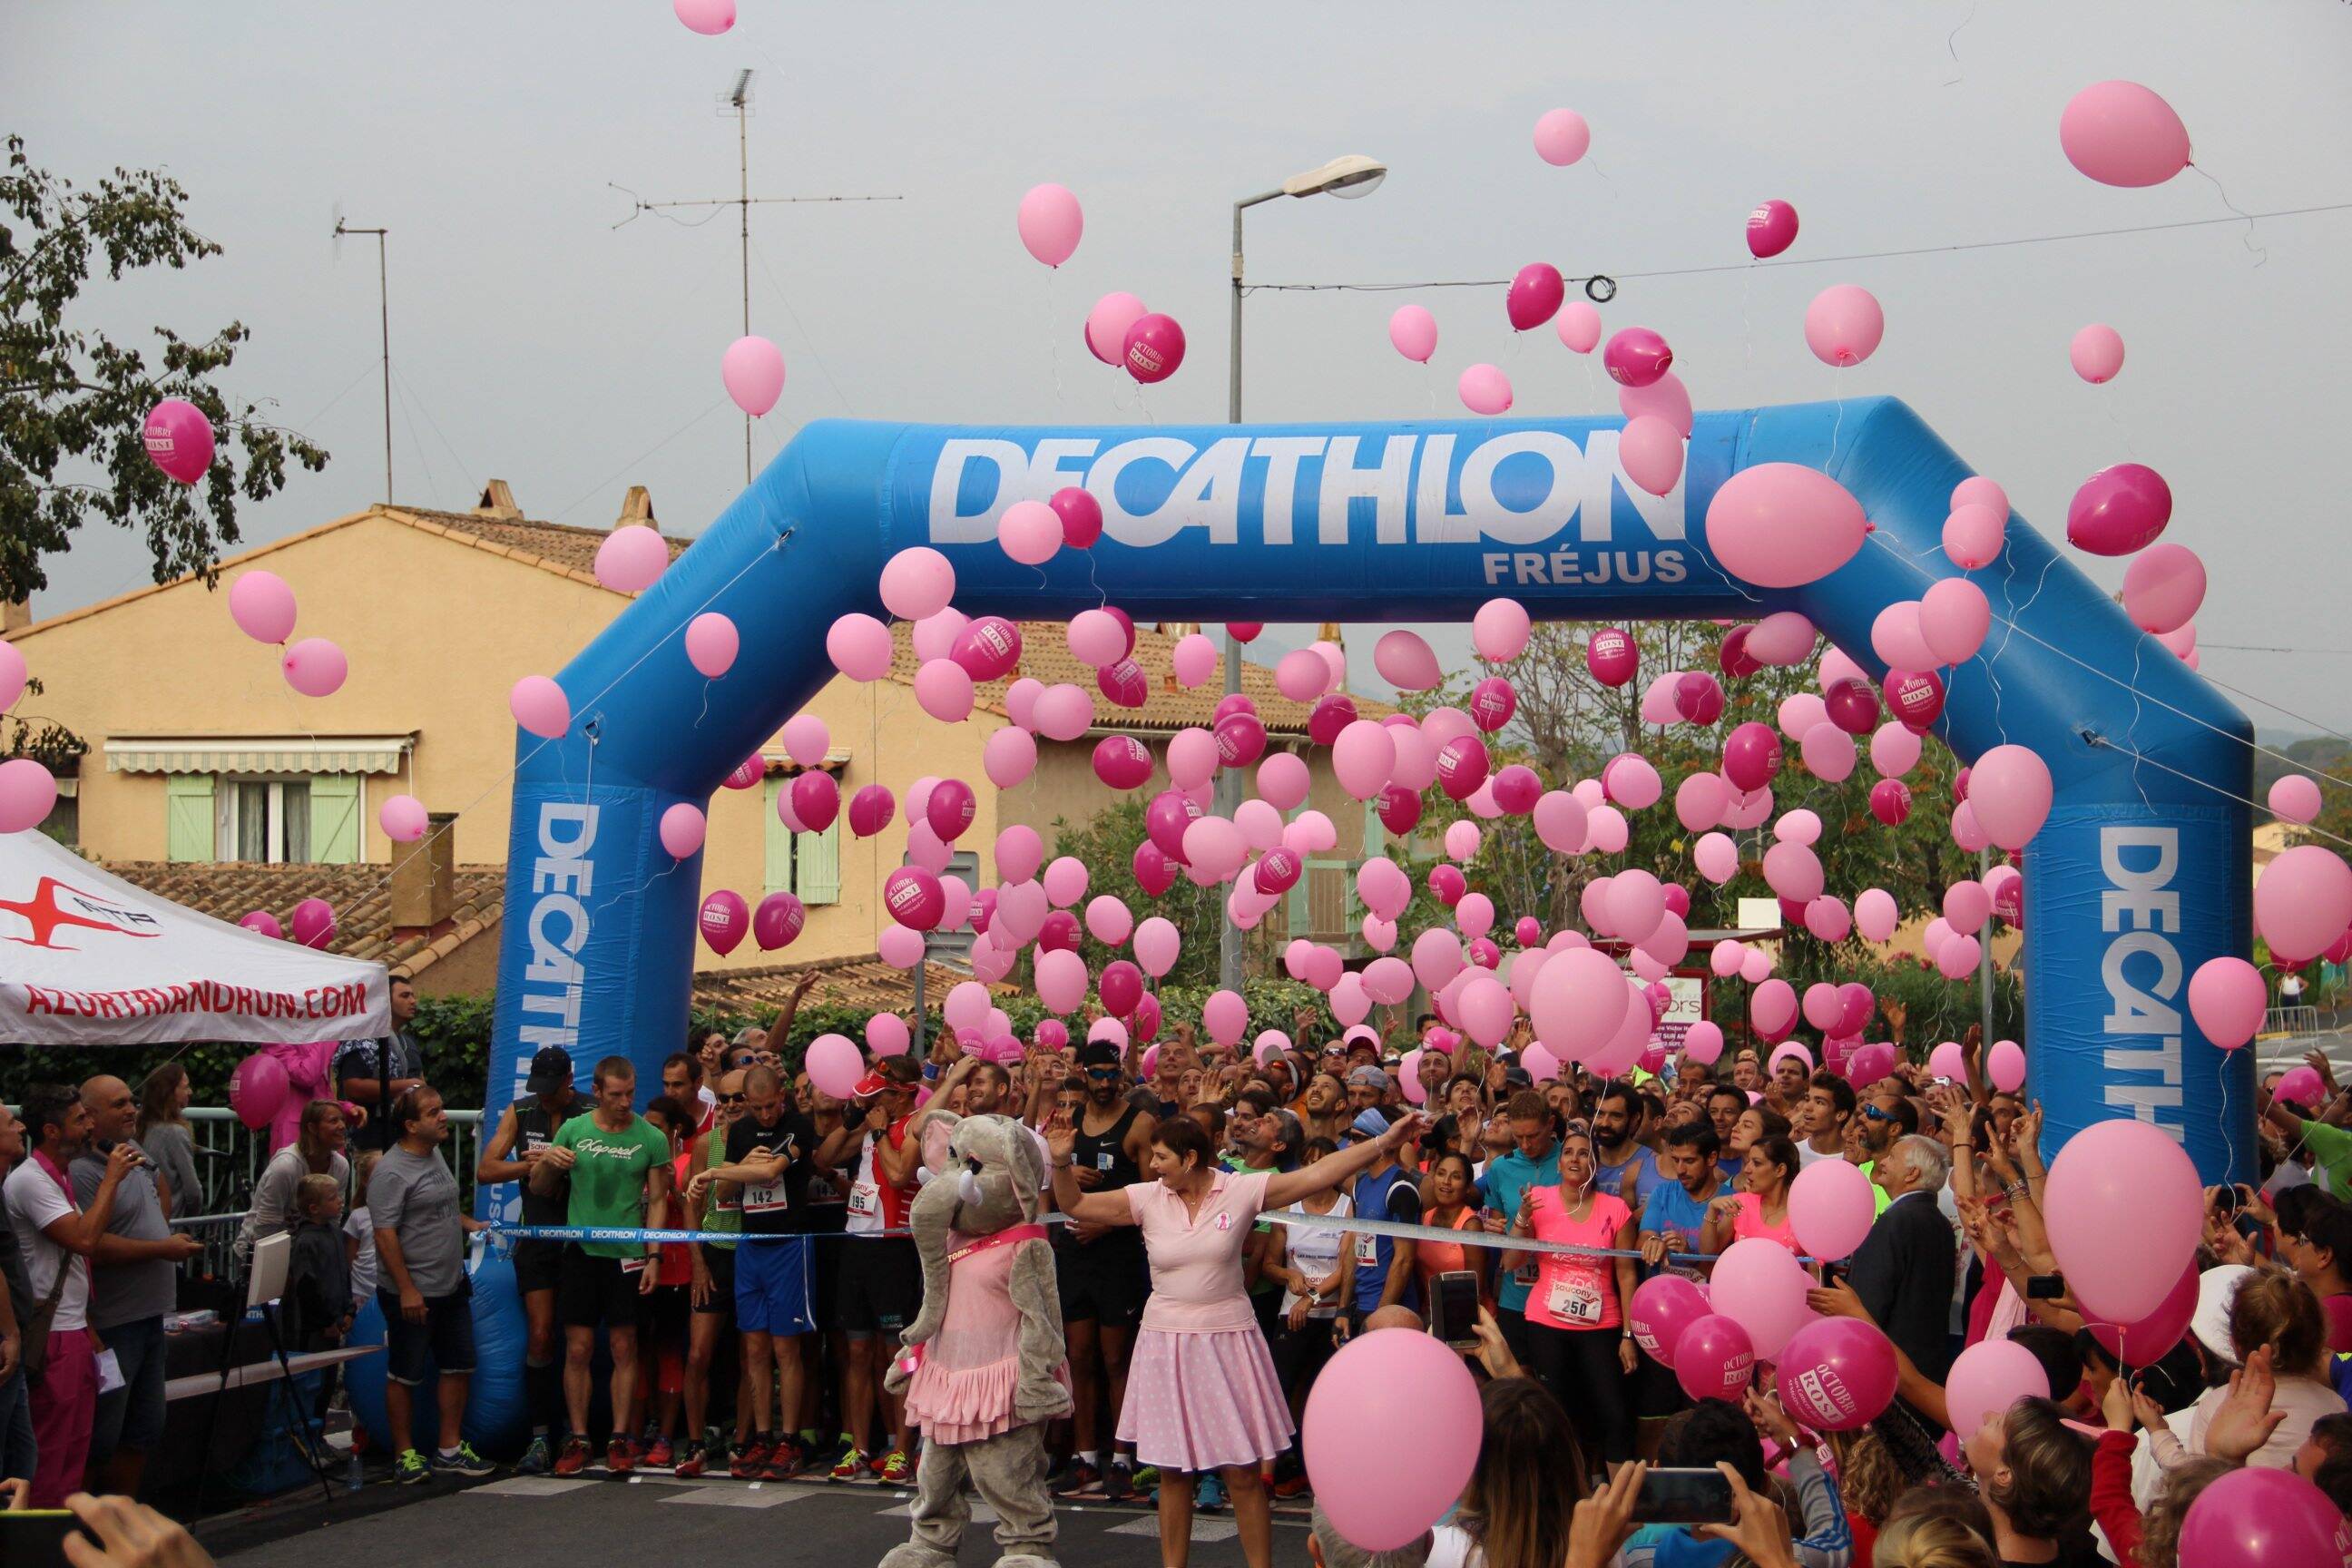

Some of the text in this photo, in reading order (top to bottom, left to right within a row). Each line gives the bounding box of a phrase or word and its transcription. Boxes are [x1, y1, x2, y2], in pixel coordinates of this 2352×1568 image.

[145, 426, 172, 437] CTOBRE
[1482, 544, 1687, 584] FRÉJUS
[983, 626, 1009, 656] ROSE
[989, 620, 1014, 647] OCTOBRE
[1596, 640, 1624, 651] ROSE
[1898, 678, 1927, 695] OCTOBRE
[1902, 686, 1932, 704] ROSE
[887, 877, 915, 899] OCTOBRE
[892, 884, 920, 906] ROSE
[703, 912, 730, 924] ROSE
[25, 979, 368, 1019] AZURTRIANDRUN.COM
[752, 1191, 773, 1204] 142
[852, 1195, 866, 1209] 195
[591, 1230, 637, 1239] DECATHLON
[643, 1230, 691, 1240] DECATHLON
[1554, 1282, 1592, 1298] saucony
[1562, 1299, 1587, 1316] 250
[1725, 1367, 1753, 1384] ROS
[1802, 1372, 1840, 1419] ROSE
[1817, 1364, 1857, 1414] OCTOBRE
